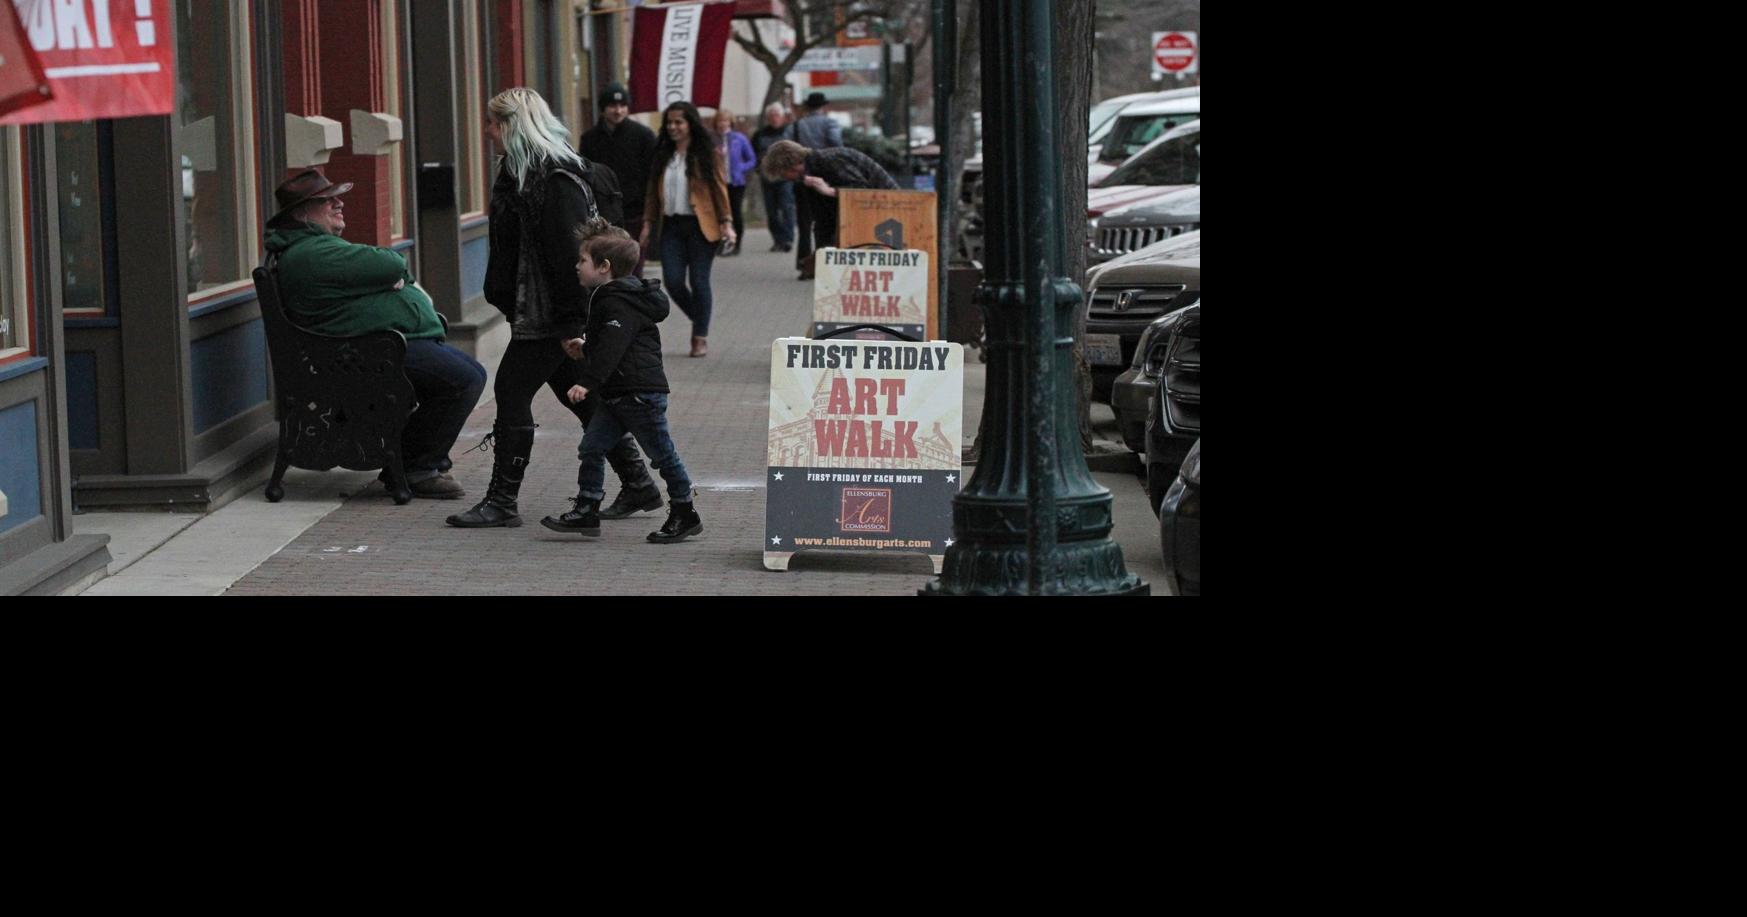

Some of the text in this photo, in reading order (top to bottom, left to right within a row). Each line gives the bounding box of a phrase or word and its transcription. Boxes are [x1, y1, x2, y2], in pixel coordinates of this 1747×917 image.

[665, 8, 694, 104] LIVE MUSIC
[825, 251, 919, 267] FIRST FRIDAY
[848, 270, 894, 293] ART
[841, 294, 901, 318] WALK
[787, 344, 950, 371] FIRST FRIDAY
[828, 377, 906, 416] ART
[814, 419, 919, 459] WALK
[807, 473, 923, 483] FIRST FRIDAY OF EACH MONTH
[794, 536, 932, 549] www.ellensburgarts.com
